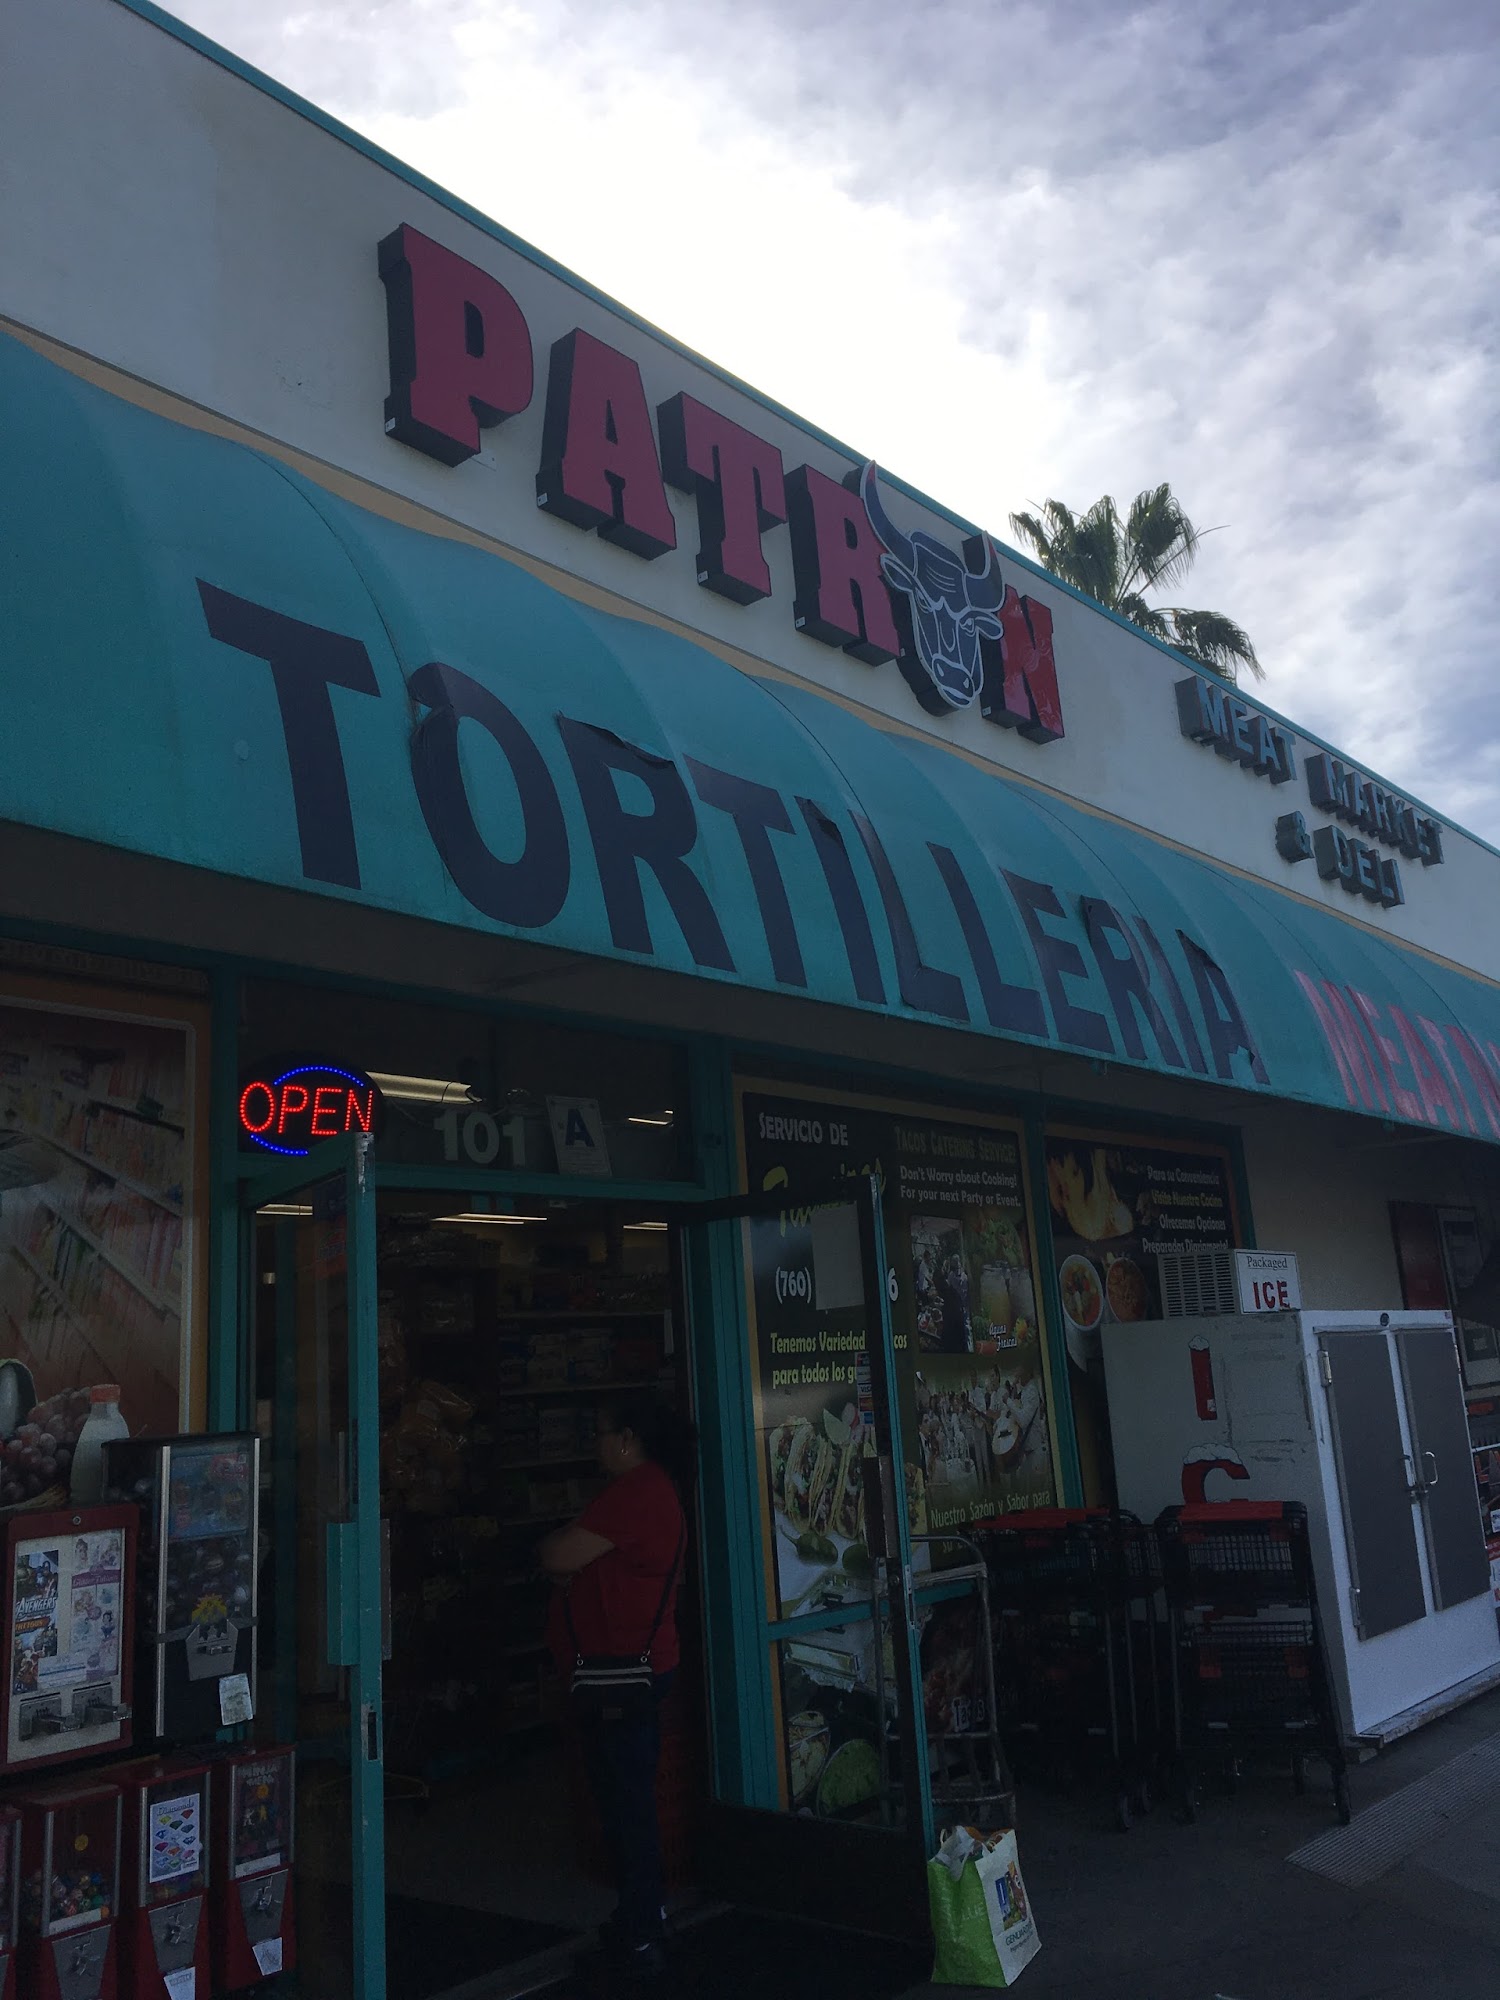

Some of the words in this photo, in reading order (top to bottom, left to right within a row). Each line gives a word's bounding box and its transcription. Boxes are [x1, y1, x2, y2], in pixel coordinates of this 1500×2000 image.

[378, 222, 1064, 744] PATRN
[1175, 675, 1297, 785] MEAT
[1306, 752, 1445, 866] MARKET
[196, 577, 1271, 1092] TORTILLERIA
[1276, 810, 1314, 863] &
[1314, 824, 1405, 908] DELI
[1293, 969, 1480, 1136] MEAT
[238, 1080, 375, 1137] OPEN
[433, 1108, 526, 1168] 101
[565, 1108, 596, 1148] A
[759, 1112, 823, 1145] SERVICIO
[830, 1123, 849, 1146] DE
[894, 1125, 927, 1154] TACOS
[930, 1131, 975, 1160] CATERING
[900, 1165, 926, 1181] Don't
[926, 1167, 954, 1187] Worry
[955, 1169, 981, 1185] about
[982, 1171, 1018, 1188] Cooking!
[1146, 1165, 1167, 1182] Para
[1166, 1171, 1175, 1182] su
[1175, 1168, 1220, 1185] Conveniencia
[900, 1185, 916, 1199] For
[917, 1190, 938, 1202] your
[940, 1191, 960, 1202] next
[961, 1190, 984, 1207] Party
[985, 1195, 995, 1205] or
[996, 1193, 1021, 1207] Event.
[1172, 1191, 1200, 1206] Nuestra
[1200, 1192, 1224, 1208] Cocina
[1158, 1213, 1196, 1230] Ofrecemos
[1196, 1215, 1227, 1232] Opciones
[1142, 1237, 1185, 1253] Preparadas
[1246, 1255, 1289, 1271] Packaged
[775, 1266, 812, 1305] (760)
[1252, 1280, 1290, 1309] ICE
[770, 1331, 817, 1355] Tenemos
[818, 1329, 866, 1351] Variedad
[893, 1333, 907, 1350] cos
[772, 1367, 799, 1390] para
[800, 1363, 830, 1384] todos
[832, 1362, 846, 1382] los
[931, 1506, 966, 1529] Nuestro
[969, 1499, 995, 1521] Sazón
[997, 1499, 1004, 1515] y
[1006, 1491, 1030, 1511] Sabor
[1033, 1490, 1051, 1509] para
[16, 1597, 57, 1617] AVENGERS
